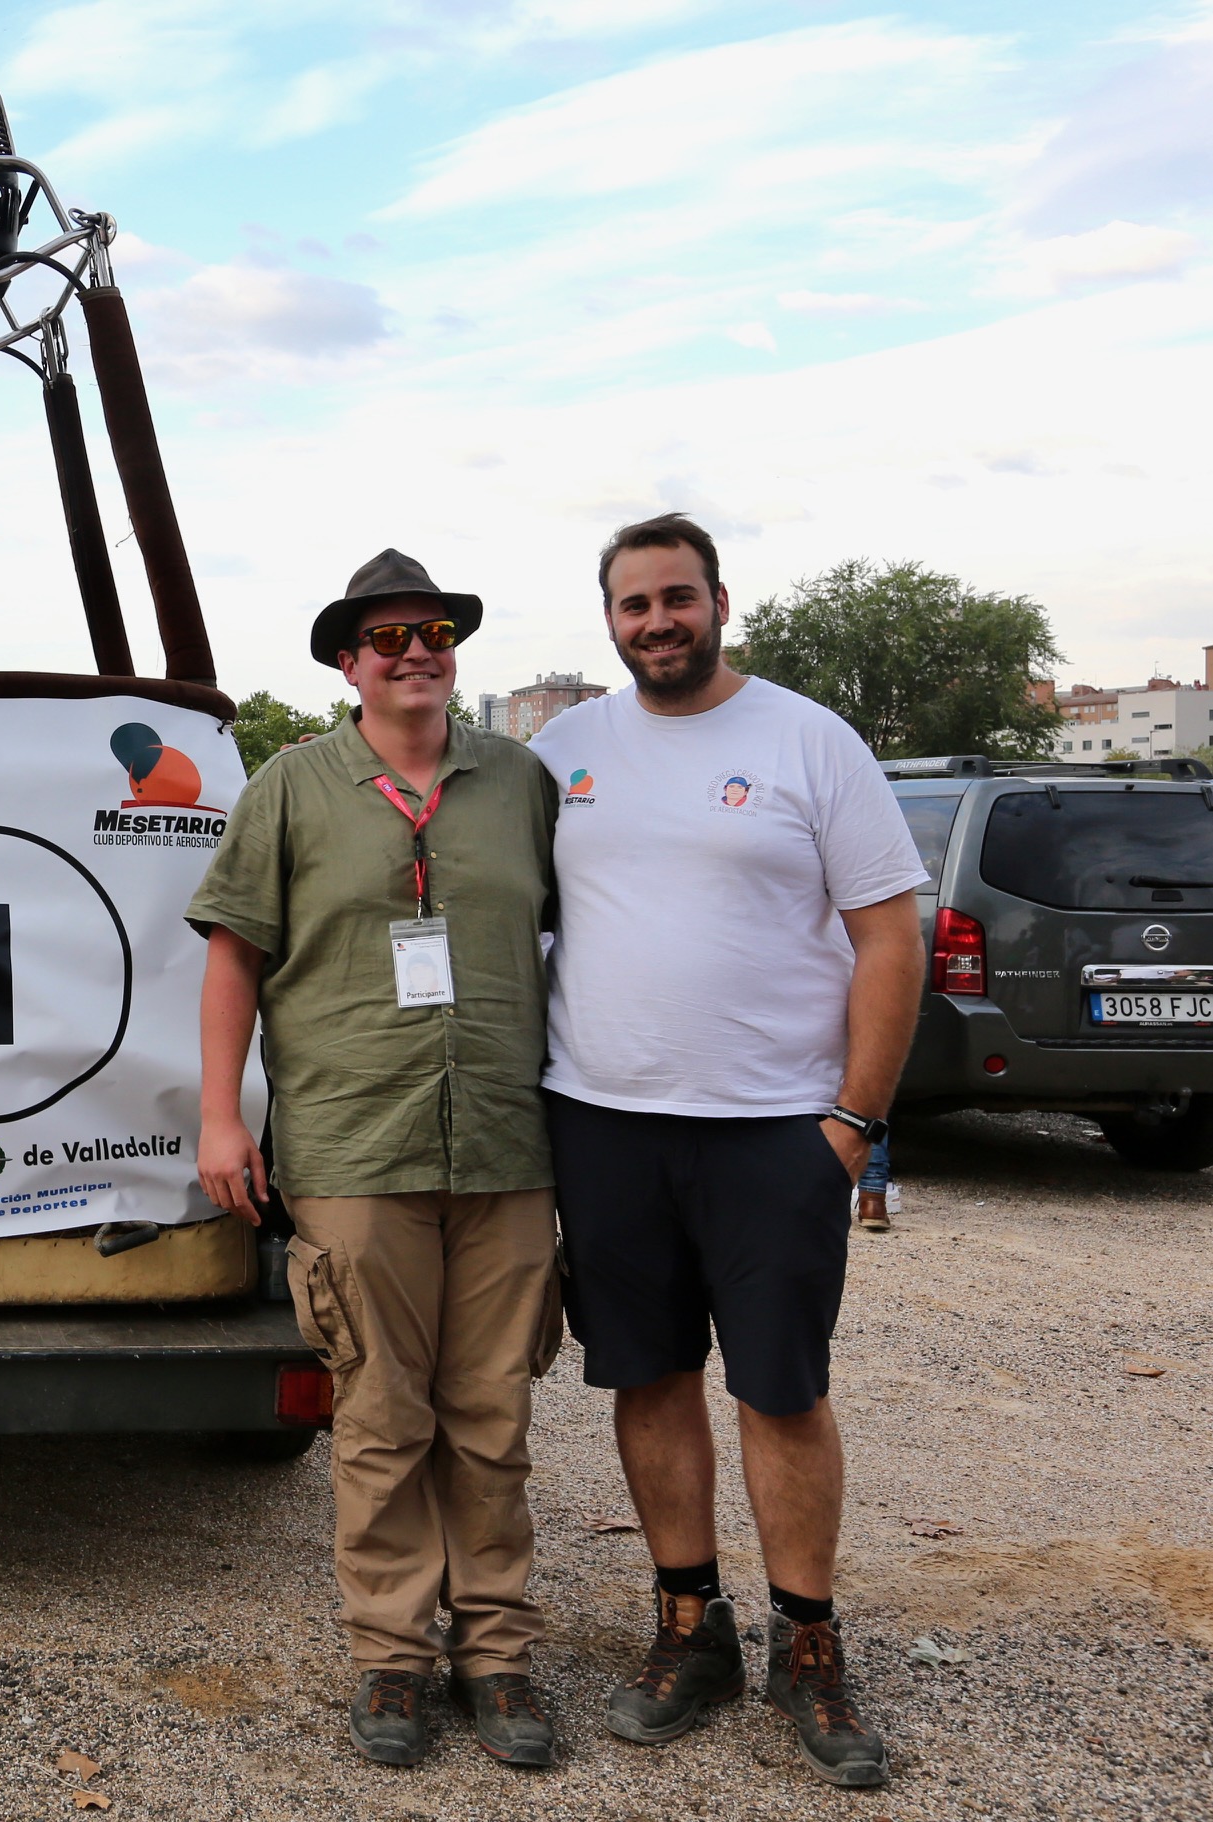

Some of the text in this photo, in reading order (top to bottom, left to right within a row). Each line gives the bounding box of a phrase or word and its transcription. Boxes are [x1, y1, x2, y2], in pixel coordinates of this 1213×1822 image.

[895, 759, 948, 769] PATHFINDER
[93, 809, 227, 837] MESETARIO
[93, 833, 221, 849] CLUB DEPORTIVO DE AEROSTACI
[994, 970, 1061, 979] PATHFINDER
[406, 989, 446, 999] Participante
[1105, 996, 1162, 1018] 3058
[1170, 997, 1212, 1018] FJC
[23, 1144, 54, 1167] de
[62, 1135, 182, 1164] Valladolid
[37, 1182, 113, 1199] Municipal
[10, 1197, 88, 1216] Deportes
